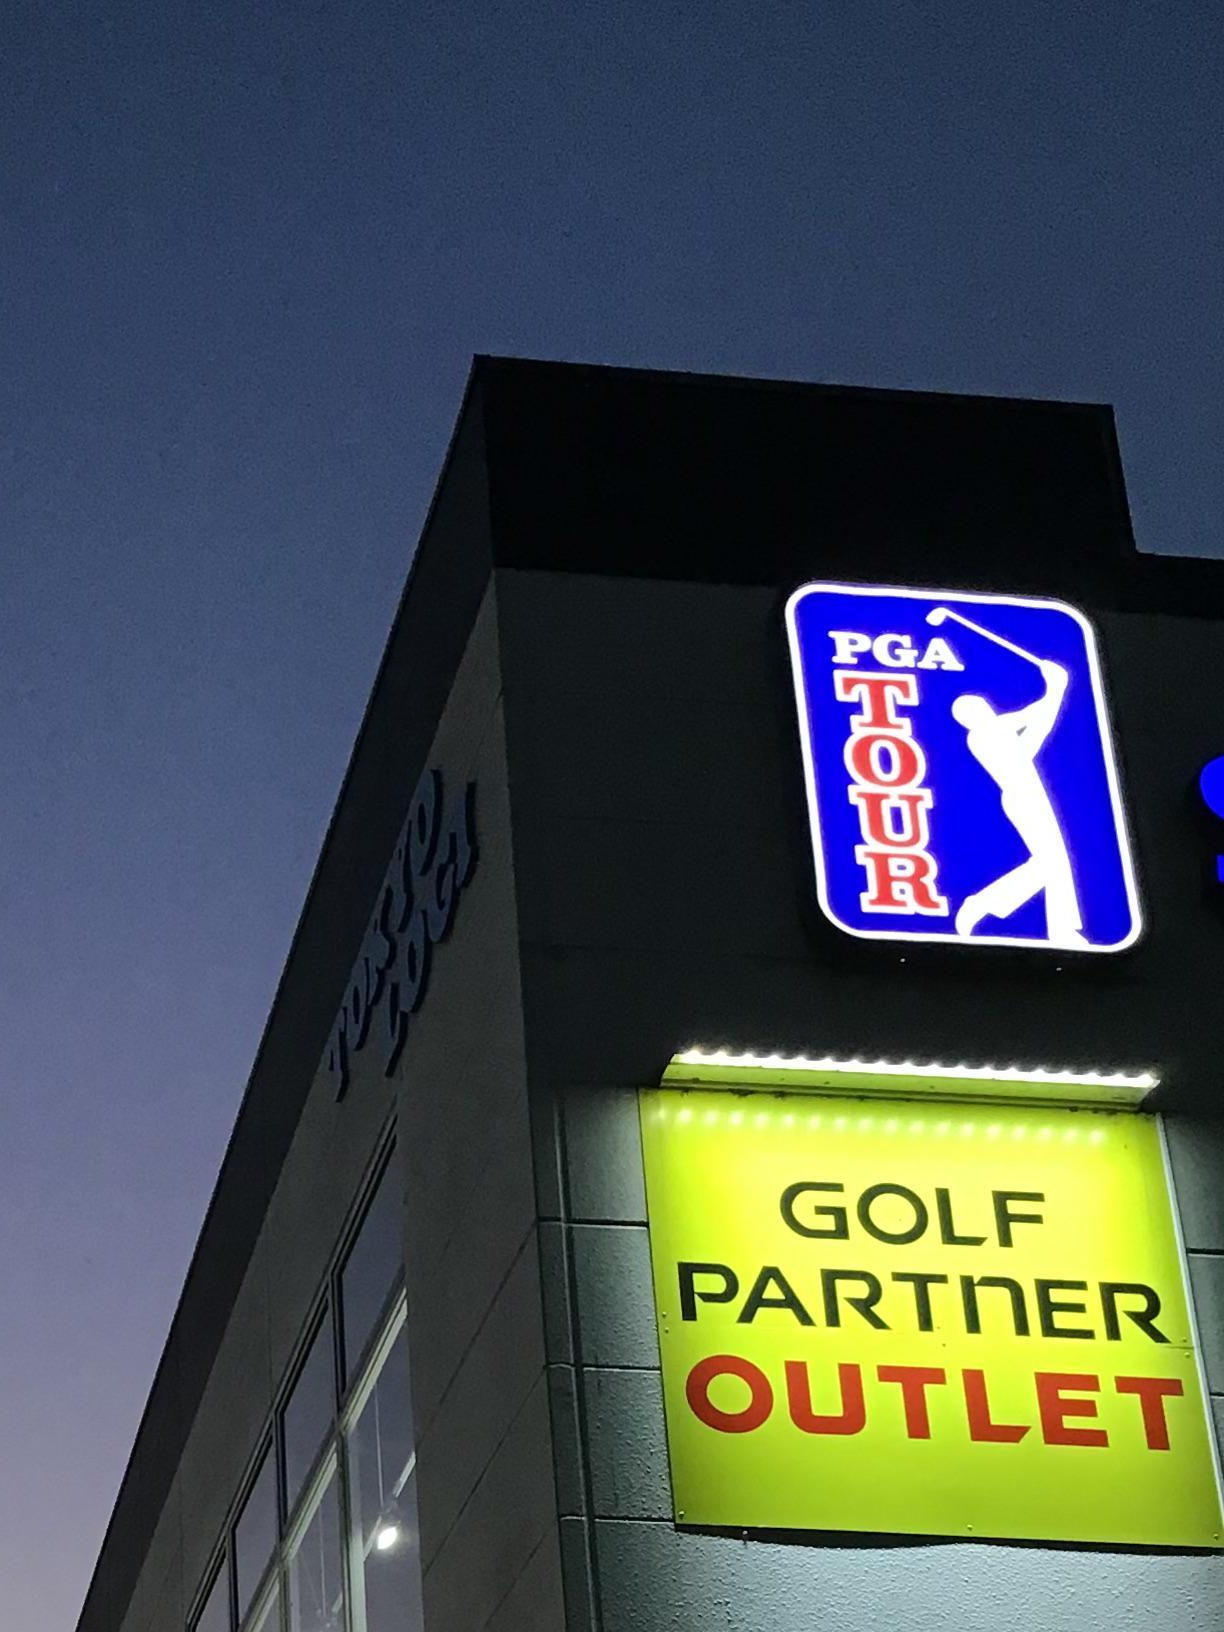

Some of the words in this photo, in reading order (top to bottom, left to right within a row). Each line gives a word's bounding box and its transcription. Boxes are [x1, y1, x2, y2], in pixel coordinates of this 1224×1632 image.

[828, 631, 964, 672] PGA
[833, 671, 949, 917] TOUR
[779, 1181, 1045, 1248] GOLF
[685, 1354, 1185, 1452] OUTLET
